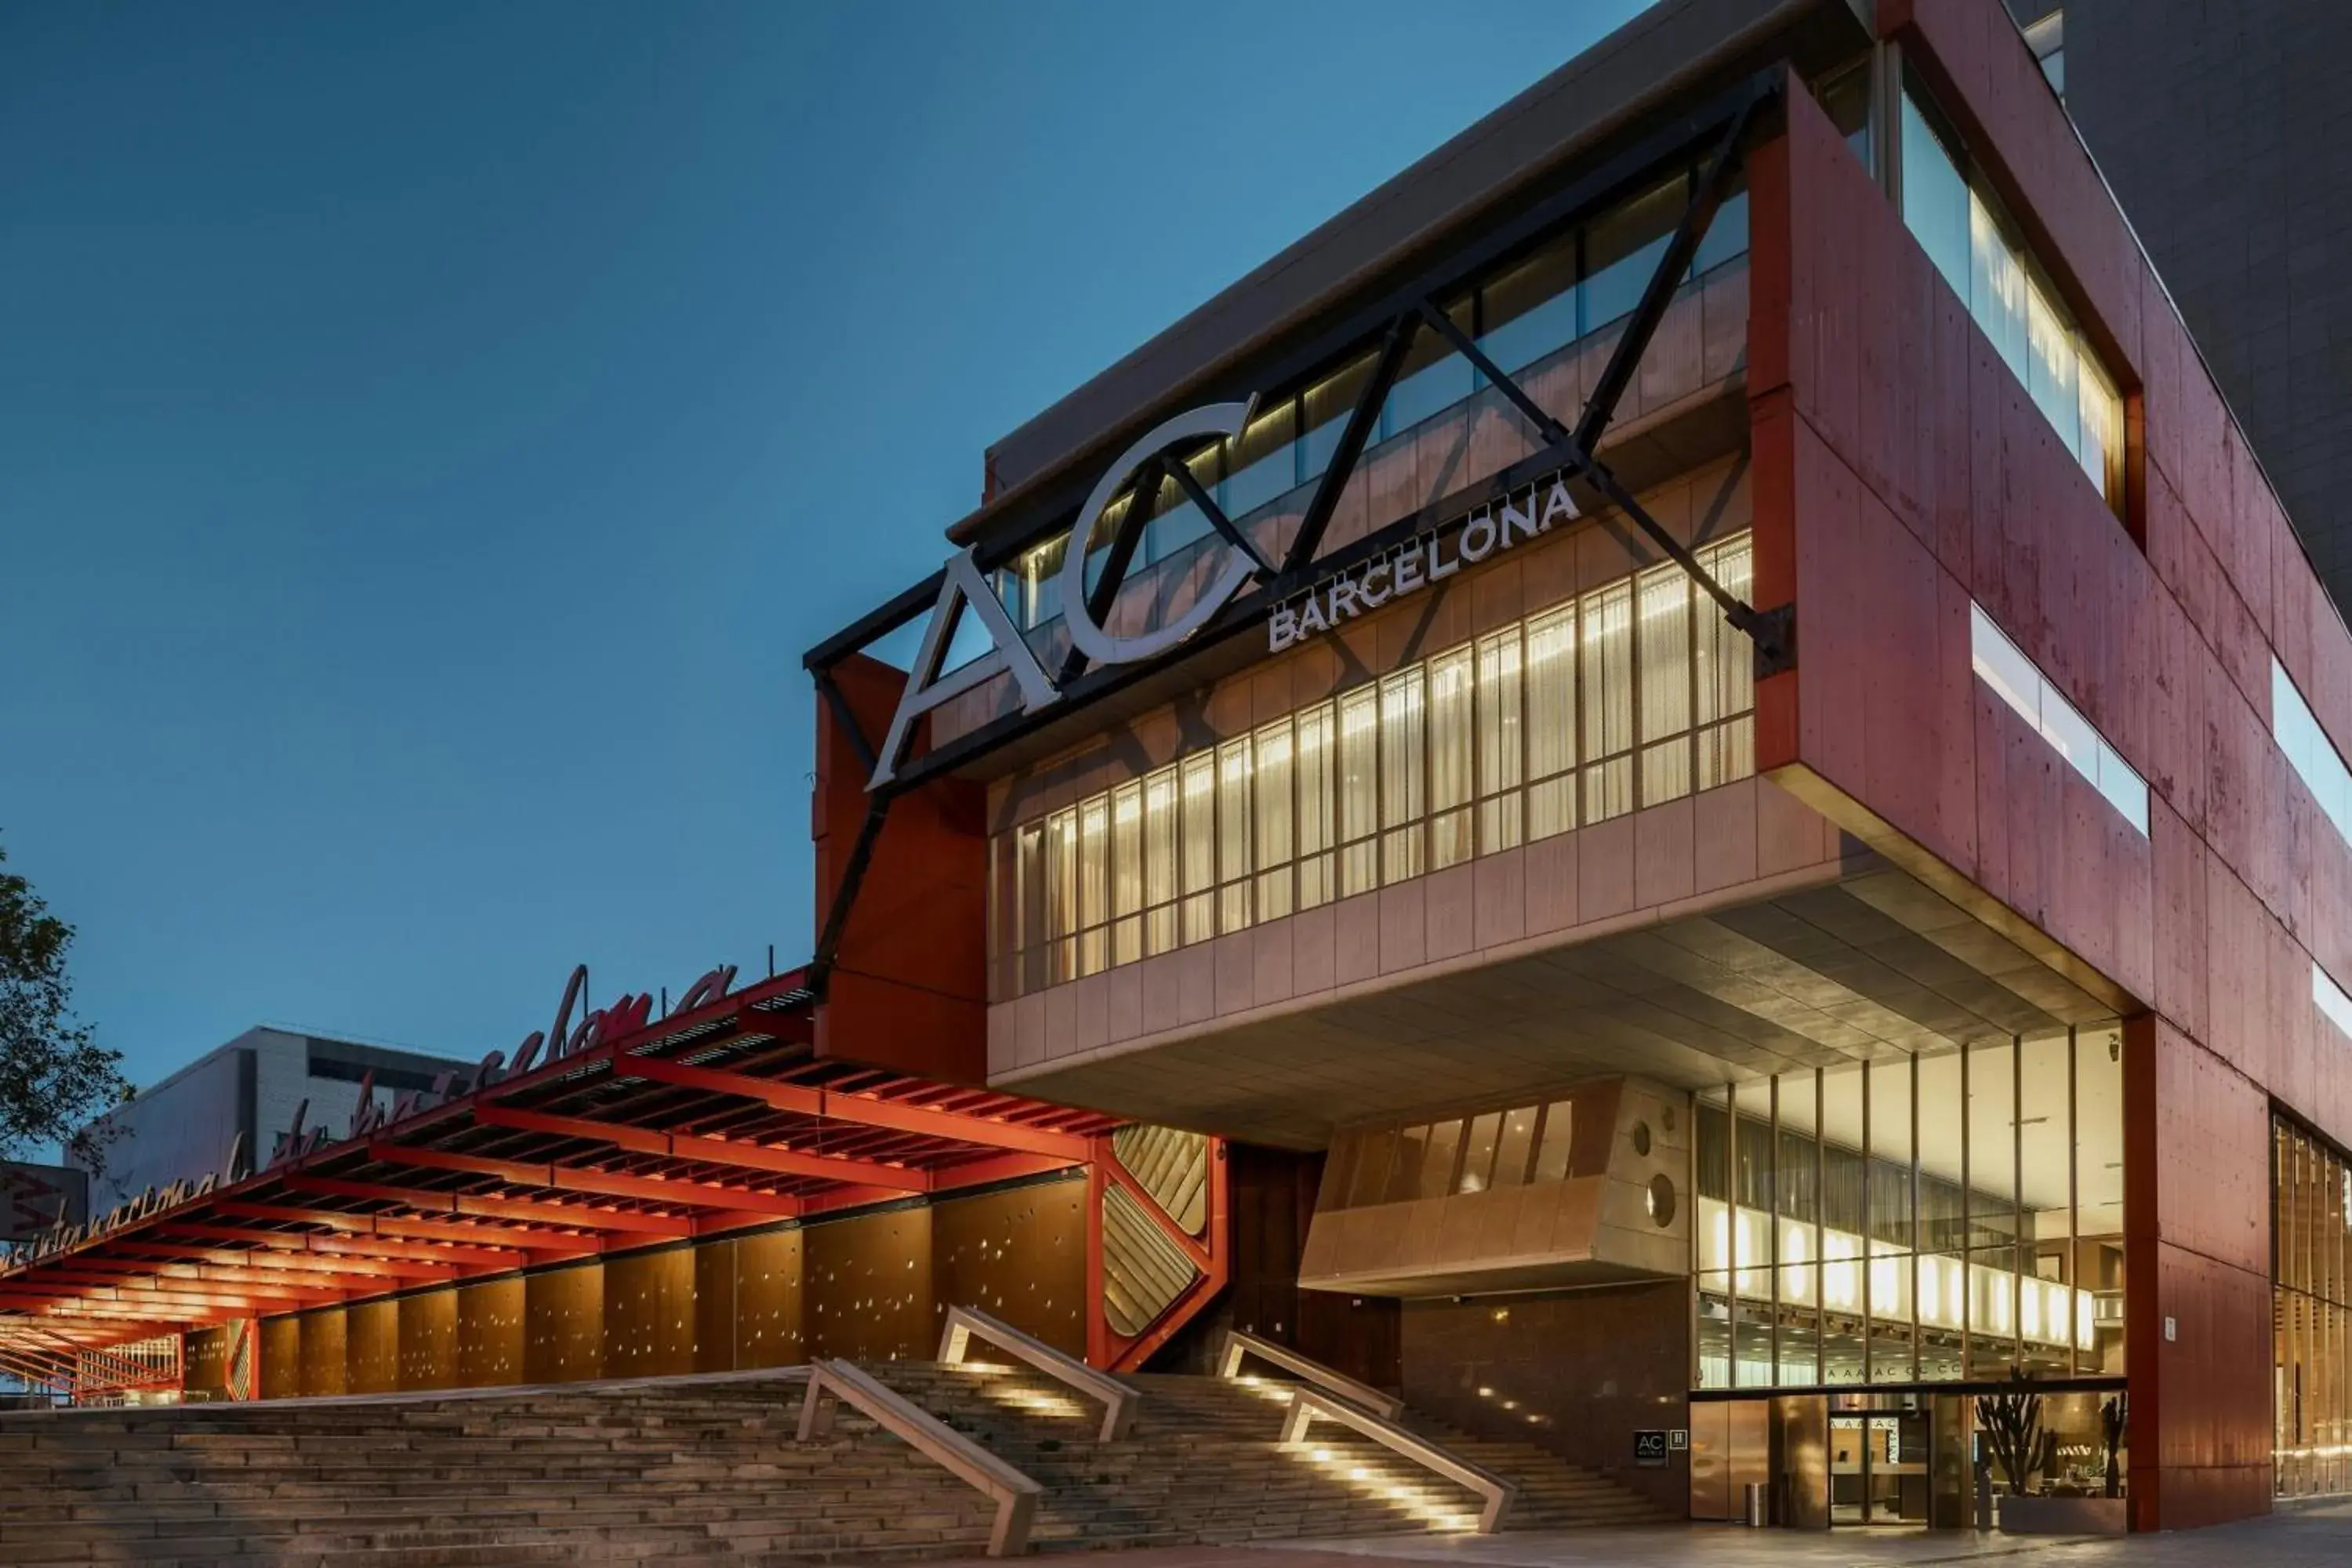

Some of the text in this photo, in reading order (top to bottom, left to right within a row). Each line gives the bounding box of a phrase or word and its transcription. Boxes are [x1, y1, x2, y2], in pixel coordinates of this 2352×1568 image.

[865, 392, 1260, 793] AC
[1269, 480, 1584, 655] BARCELONA
[1638, 1436, 1663, 1450] AC
